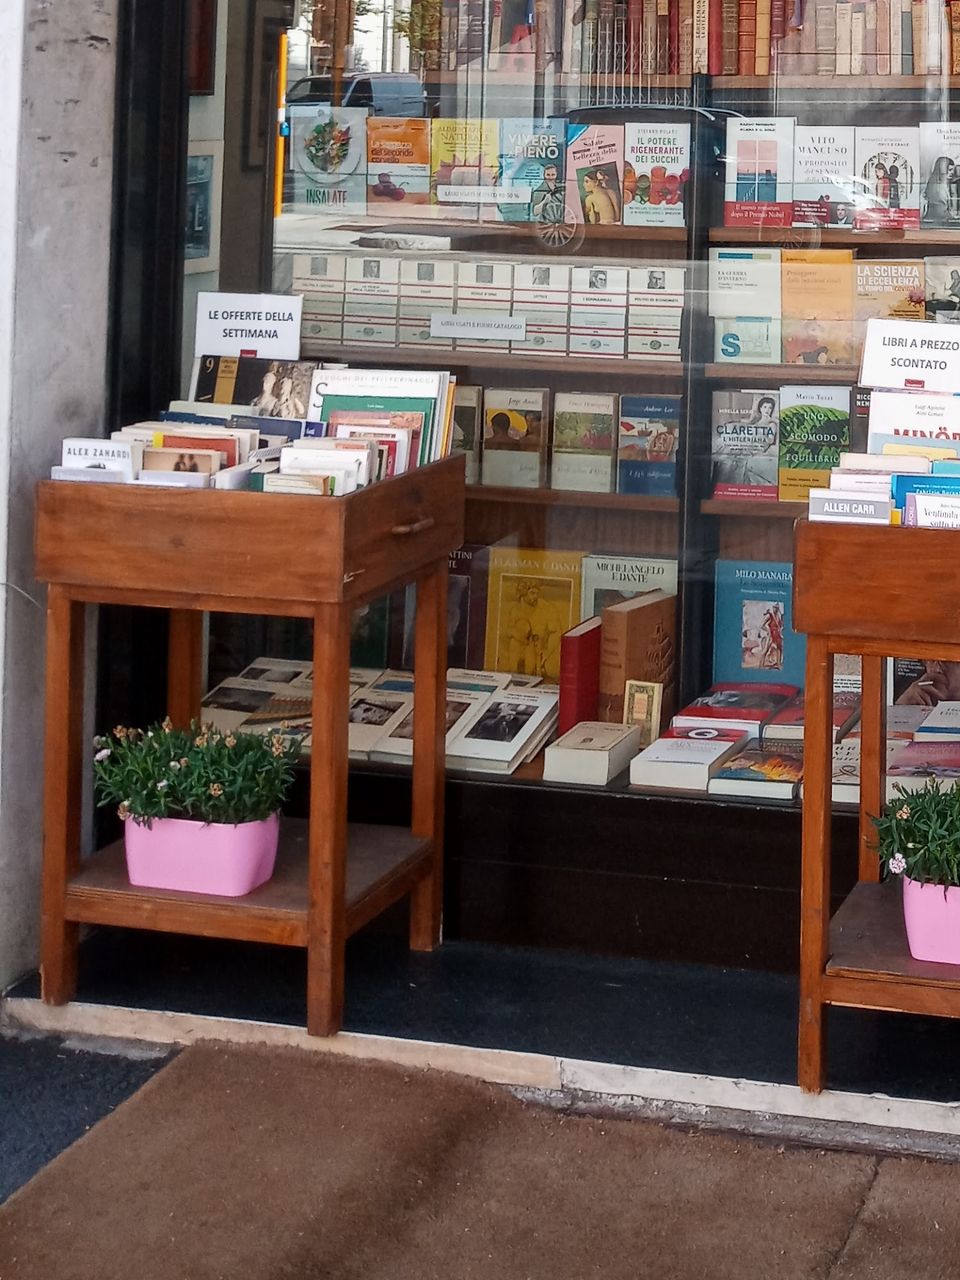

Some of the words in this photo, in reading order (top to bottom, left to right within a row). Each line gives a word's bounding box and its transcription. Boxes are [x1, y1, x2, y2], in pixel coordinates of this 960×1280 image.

[508, 134, 558, 147] VIVERE
[637, 137, 645, 146] IL
[648, 137, 677, 146] POTERE
[810, 136, 835, 145] VITO
[630, 146, 684, 155] RIGENERANTE
[635, 155, 649, 164] DEI
[650, 155, 680, 164] SUCCHI
[306, 189, 348, 208] INSALATE
[857, 266, 871, 277] LA
[874, 266, 920, 277] SCIENZA
[857, 277, 866, 285] DI
[868, 277, 920, 286] ECCELLENZA
[208, 310, 219, 320] LE
[221, 310, 263, 321] OFFERTE
[265, 312, 294, 322] DELLA
[222, 328, 279, 339] SETTIMANA
[882, 336, 908, 347] LIBRI
[909, 338, 918, 348] A
[920, 339, 960, 351] PREZZO
[206, 357, 214, 373] 9
[890, 357, 948, 370] SCONTATO
[796, 393, 815, 401] Mario
[804, 412, 825, 420] UNO
[716, 425, 775, 437] CLARETTA
[790, 432, 838, 442] SCOMODO
[67, 447, 89, 457] ALEX
[93, 448, 130, 459] ZANARDI
[823, 501, 850, 514] ALLEN
[852, 503, 875, 515] CARR
[596, 561, 665, 576] MICHELANGELO
[618, 572, 648, 584] DANTE
[735, 569, 756, 579] MILO
[757, 570, 793, 582] MANARA
